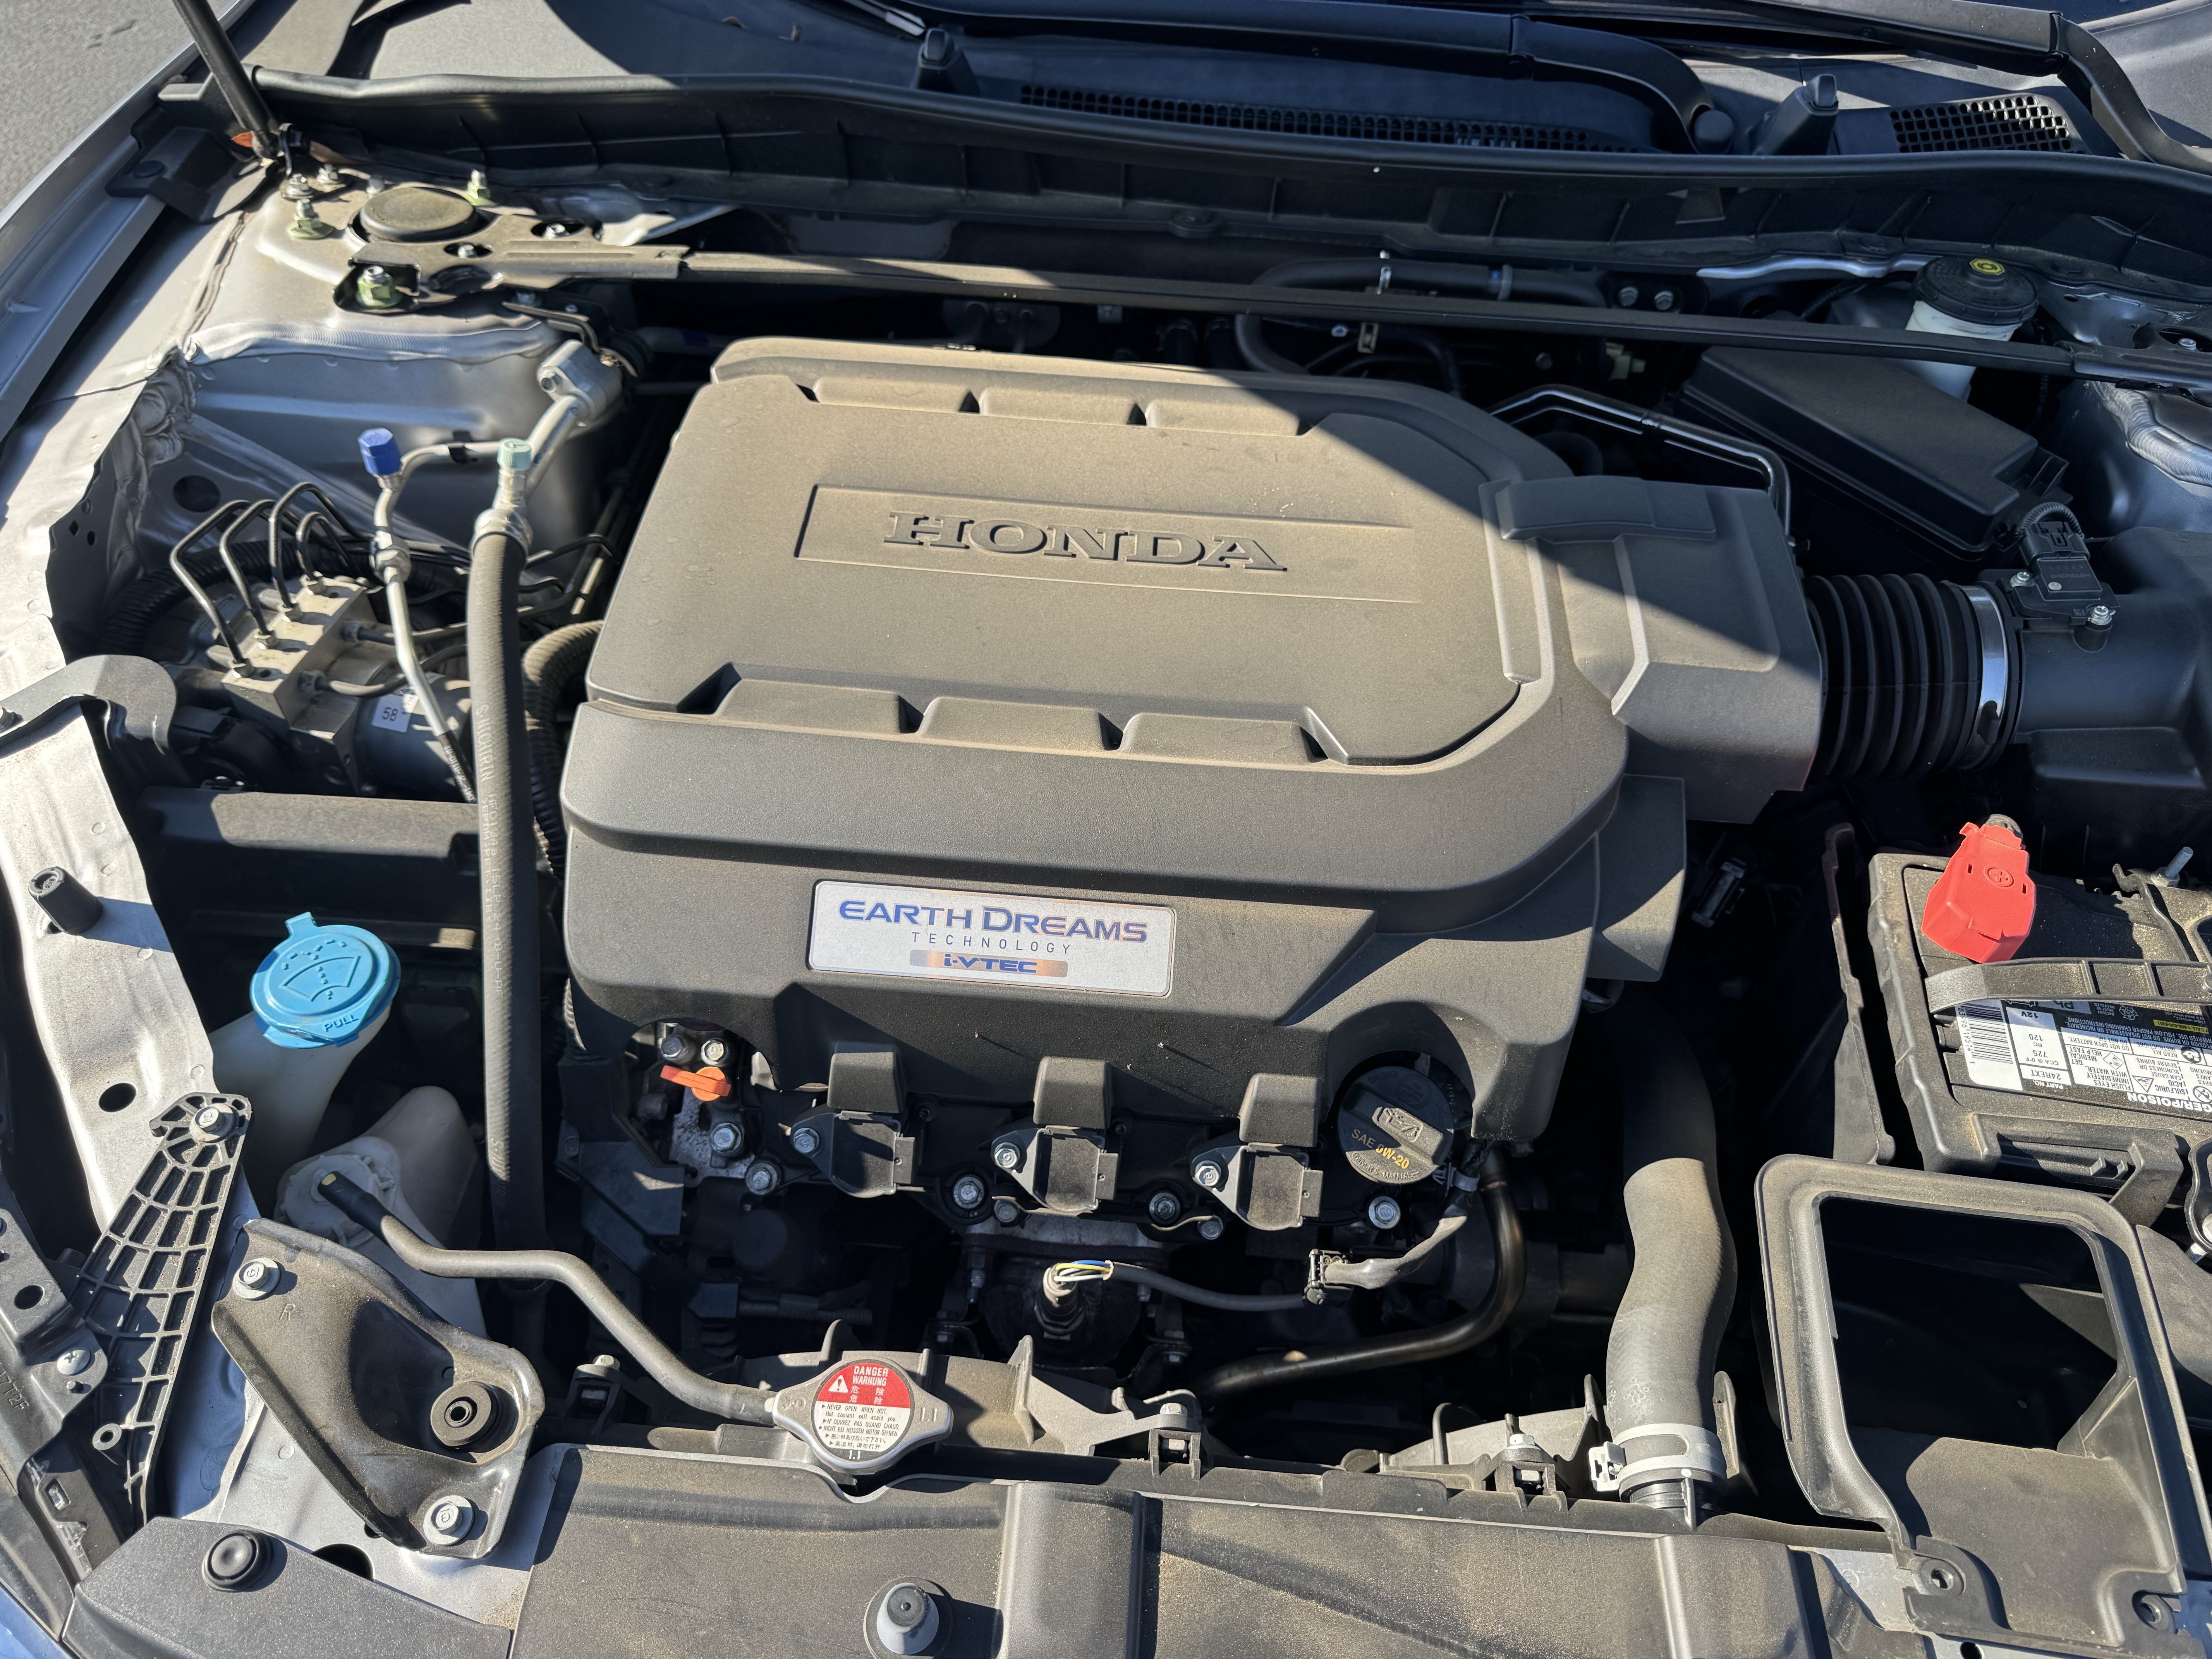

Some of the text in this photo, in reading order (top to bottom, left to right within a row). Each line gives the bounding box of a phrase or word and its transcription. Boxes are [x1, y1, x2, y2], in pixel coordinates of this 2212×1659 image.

[883, 511, 1288, 572] HONDA
[382, 707, 398, 721] 58
[839, 900, 1148, 944] EARTH DREAMS
[912, 931, 1071, 955] TECHNOLOGY
[944, 953, 1037, 974] i-VTEC
[323, 1014, 359, 1032] PULL
[2065, 1022, 2096, 1032] INCINERATE.
[2066, 1017, 2104, 1027] INSTRUCTIONS.
[2105, 1022, 2131, 1031] CHARGING
[2106, 1028, 2140, 1038] DISASSEMBLE
[2132, 1026, 2153, 1035] PROPER
[1963, 1033, 1973, 1051] 19514
[2068, 1037, 2092, 1046] BATTERY.
[2134, 1041, 2176, 1052] INSTRUCTIONS.
[2069, 1052, 2097, 1061] MEDICAL
[2031, 1069, 2061, 1080] 24REXT
[2085, 1066, 2109, 1075] WATER.
[2149, 1065, 2179, 1074] BLINDNESS
[2190, 1067, 2212, 1075] MOKING
[2087, 1072, 2129, 1084] IMMEDIATELY
[2046, 1081, 2063, 1089] PART
[2111, 1083, 2131, 1091] FLUSH
[2155, 1085, 2186, 1095] SULFURIC
[1352, 1128, 1410, 1169] SAE 0W-20
[1382, 1171, 1412, 1180] MANUAL
[280, 1303, 296, 1321] R
[854, 1365, 888, 1377] DANGER
[852, 1375, 887, 1386] WARNUNG
[921, 1407, 938, 1423] 1.1
[848, 1450, 861, 1460] 1.1
